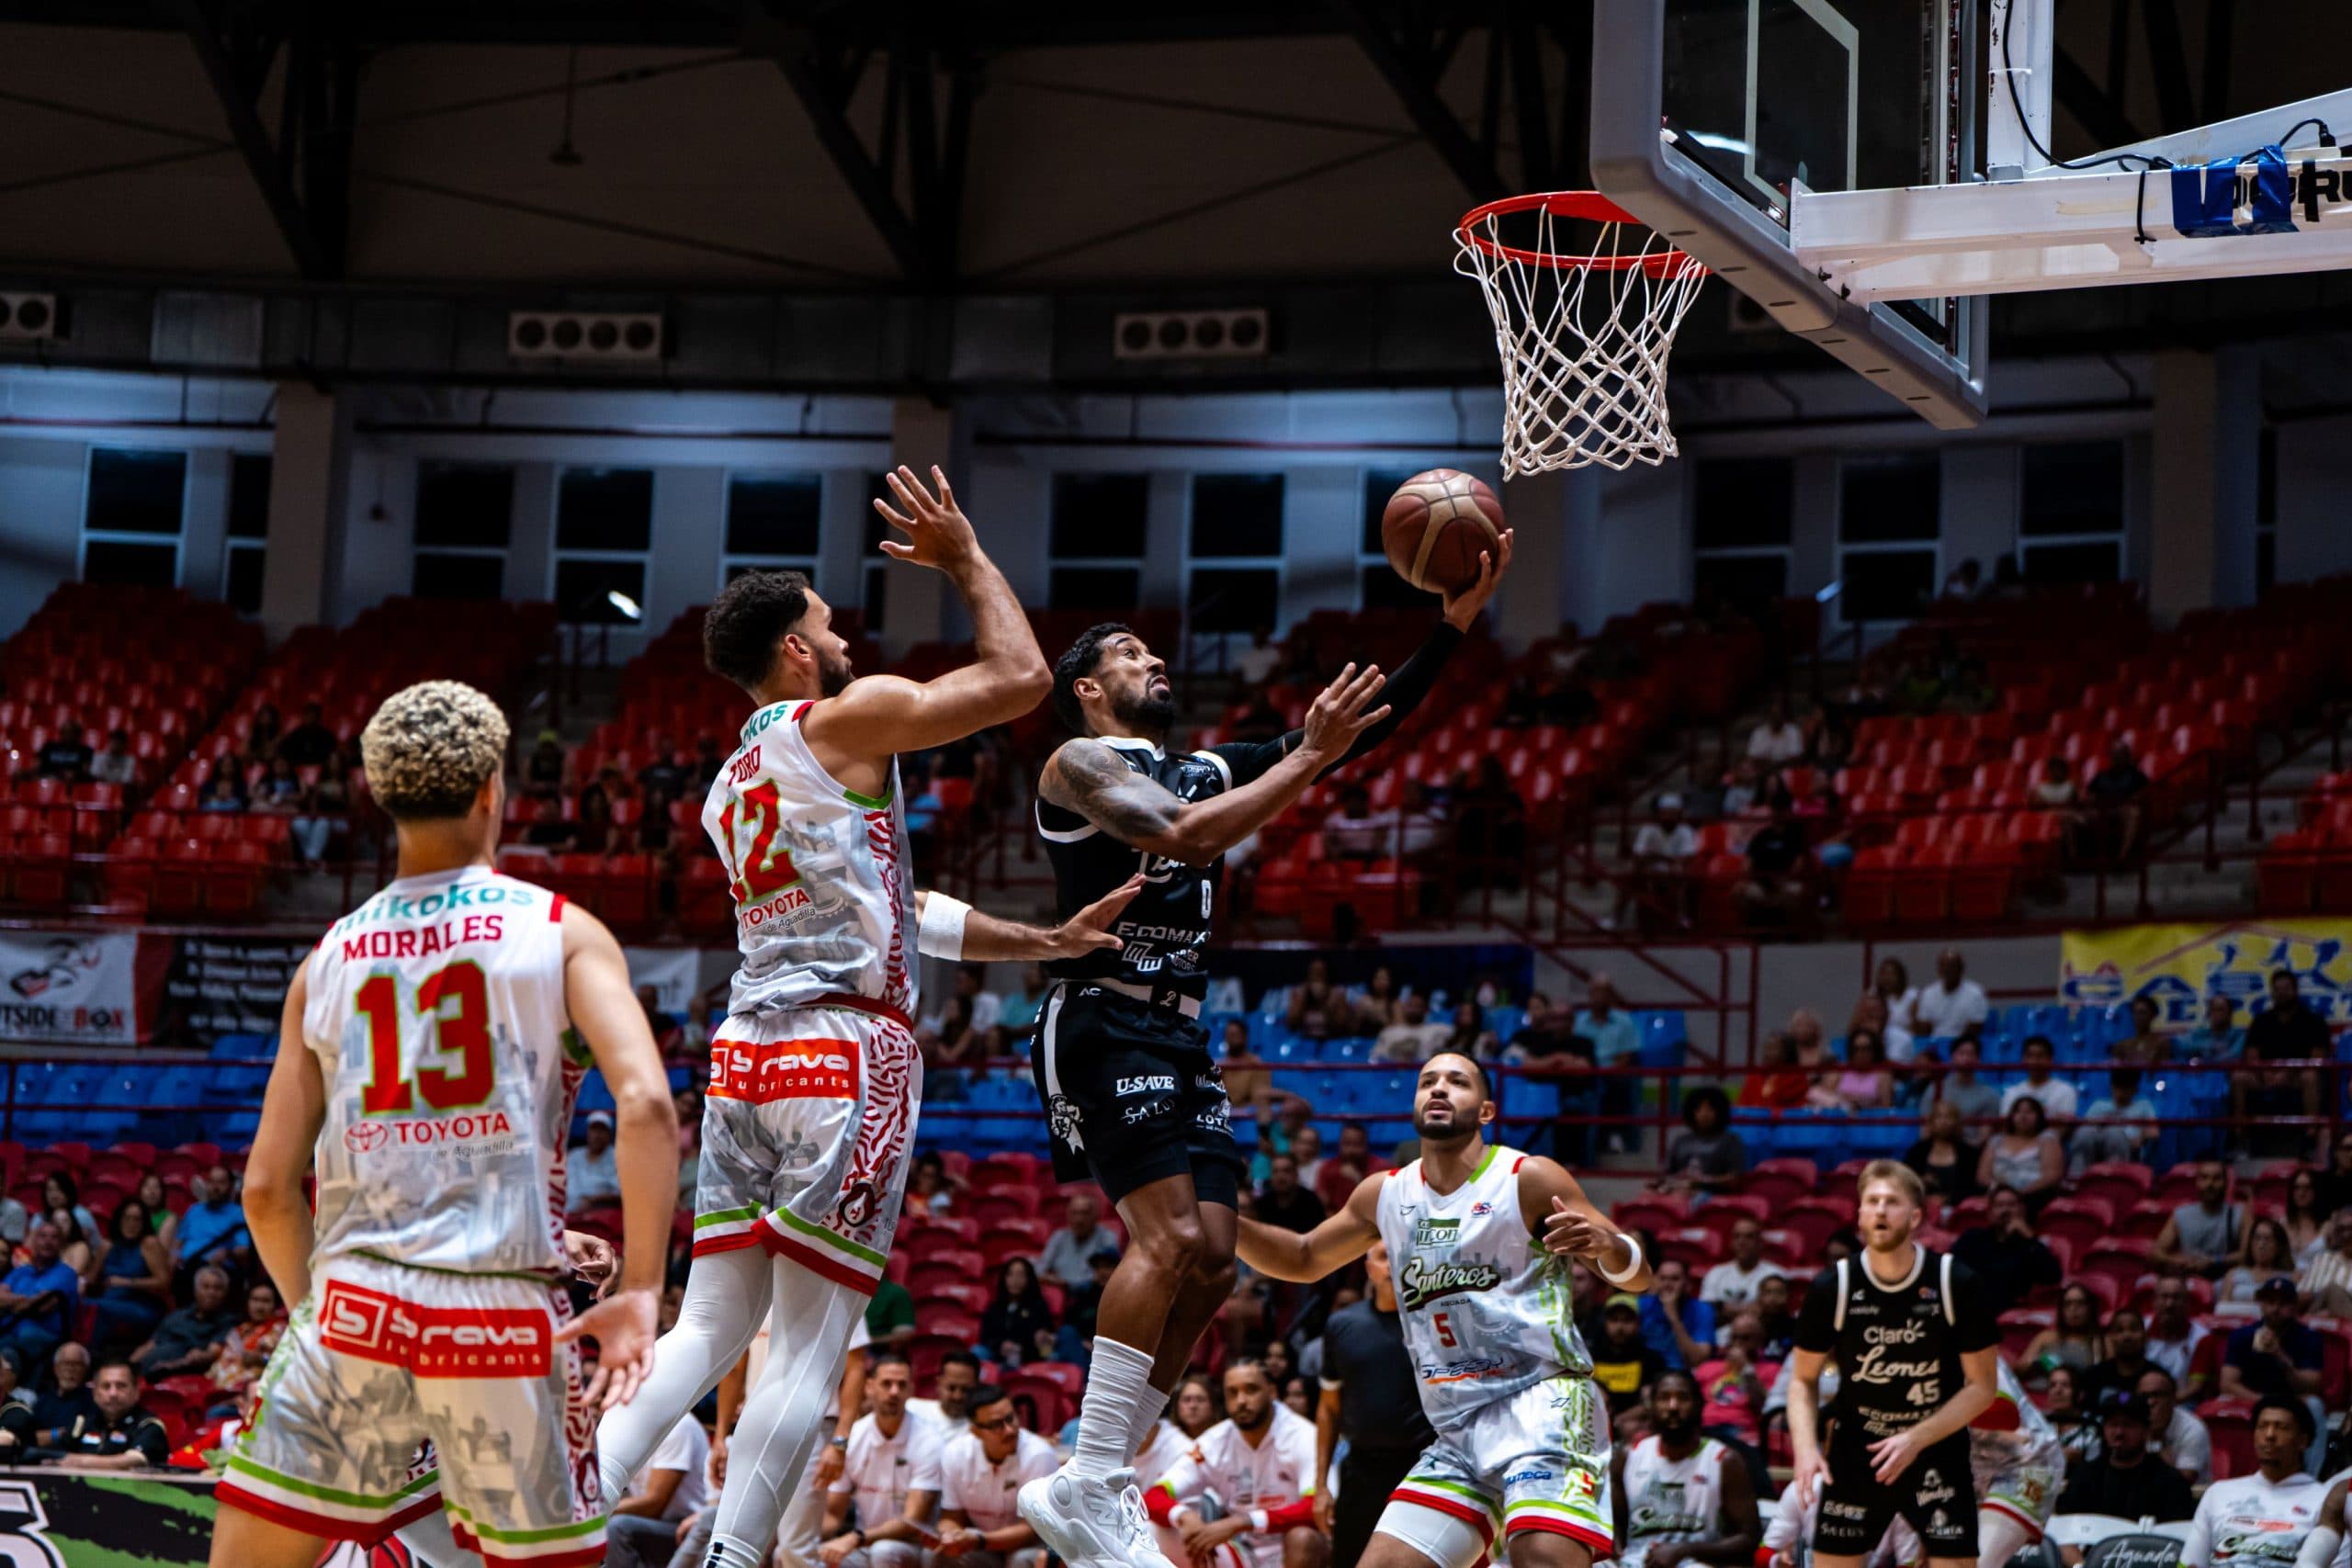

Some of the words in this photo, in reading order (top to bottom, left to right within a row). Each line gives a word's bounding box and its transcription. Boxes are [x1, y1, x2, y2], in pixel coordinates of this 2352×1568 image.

[719, 778, 803, 908] 12
[740, 888, 810, 930] TOYOTA
[343, 915, 503, 964] MORALES
[1116, 920, 1212, 945] ECOMAX
[353, 957, 496, 1118] 13
[1115, 1076, 1175, 1095] U-SAVE
[394, 1111, 511, 1145] TOYOTA
[1402, 1257, 1498, 1308] Santeros
[1433, 1313, 1457, 1348] 5
[1863, 1324, 1917, 1345] Claro
[1851, 1346, 1940, 1384] Leones
[1906, 1379, 1940, 1406] 45
